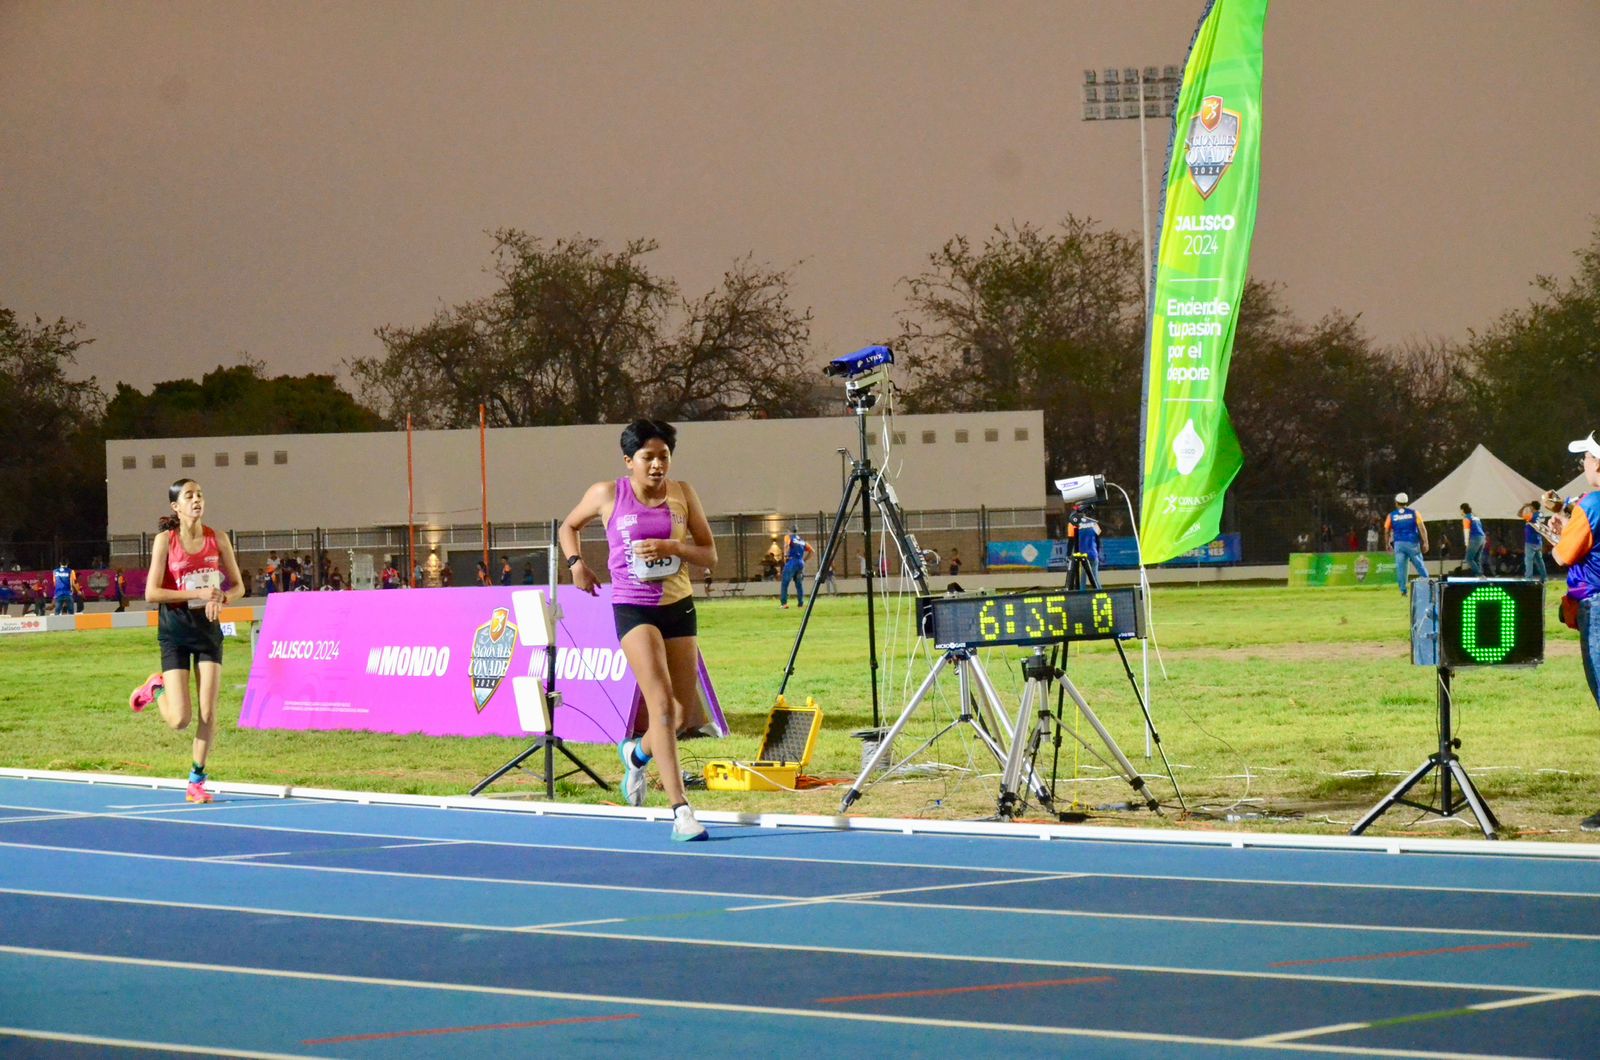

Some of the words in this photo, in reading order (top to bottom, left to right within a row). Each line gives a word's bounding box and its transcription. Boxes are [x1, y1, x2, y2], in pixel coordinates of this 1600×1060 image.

[1193, 166, 1220, 175] 2024
[1175, 214, 1236, 231] JALISCO
[1183, 234, 1218, 256] 2024
[1188, 341, 1203, 359] el
[979, 592, 1113, 641] 6:35.0
[1462, 586, 1515, 661] 0
[268, 640, 314, 659] JALISCO
[312, 640, 341, 660] 2024
[376, 645, 451, 677] MONDO
[475, 679, 497, 687] 2024
